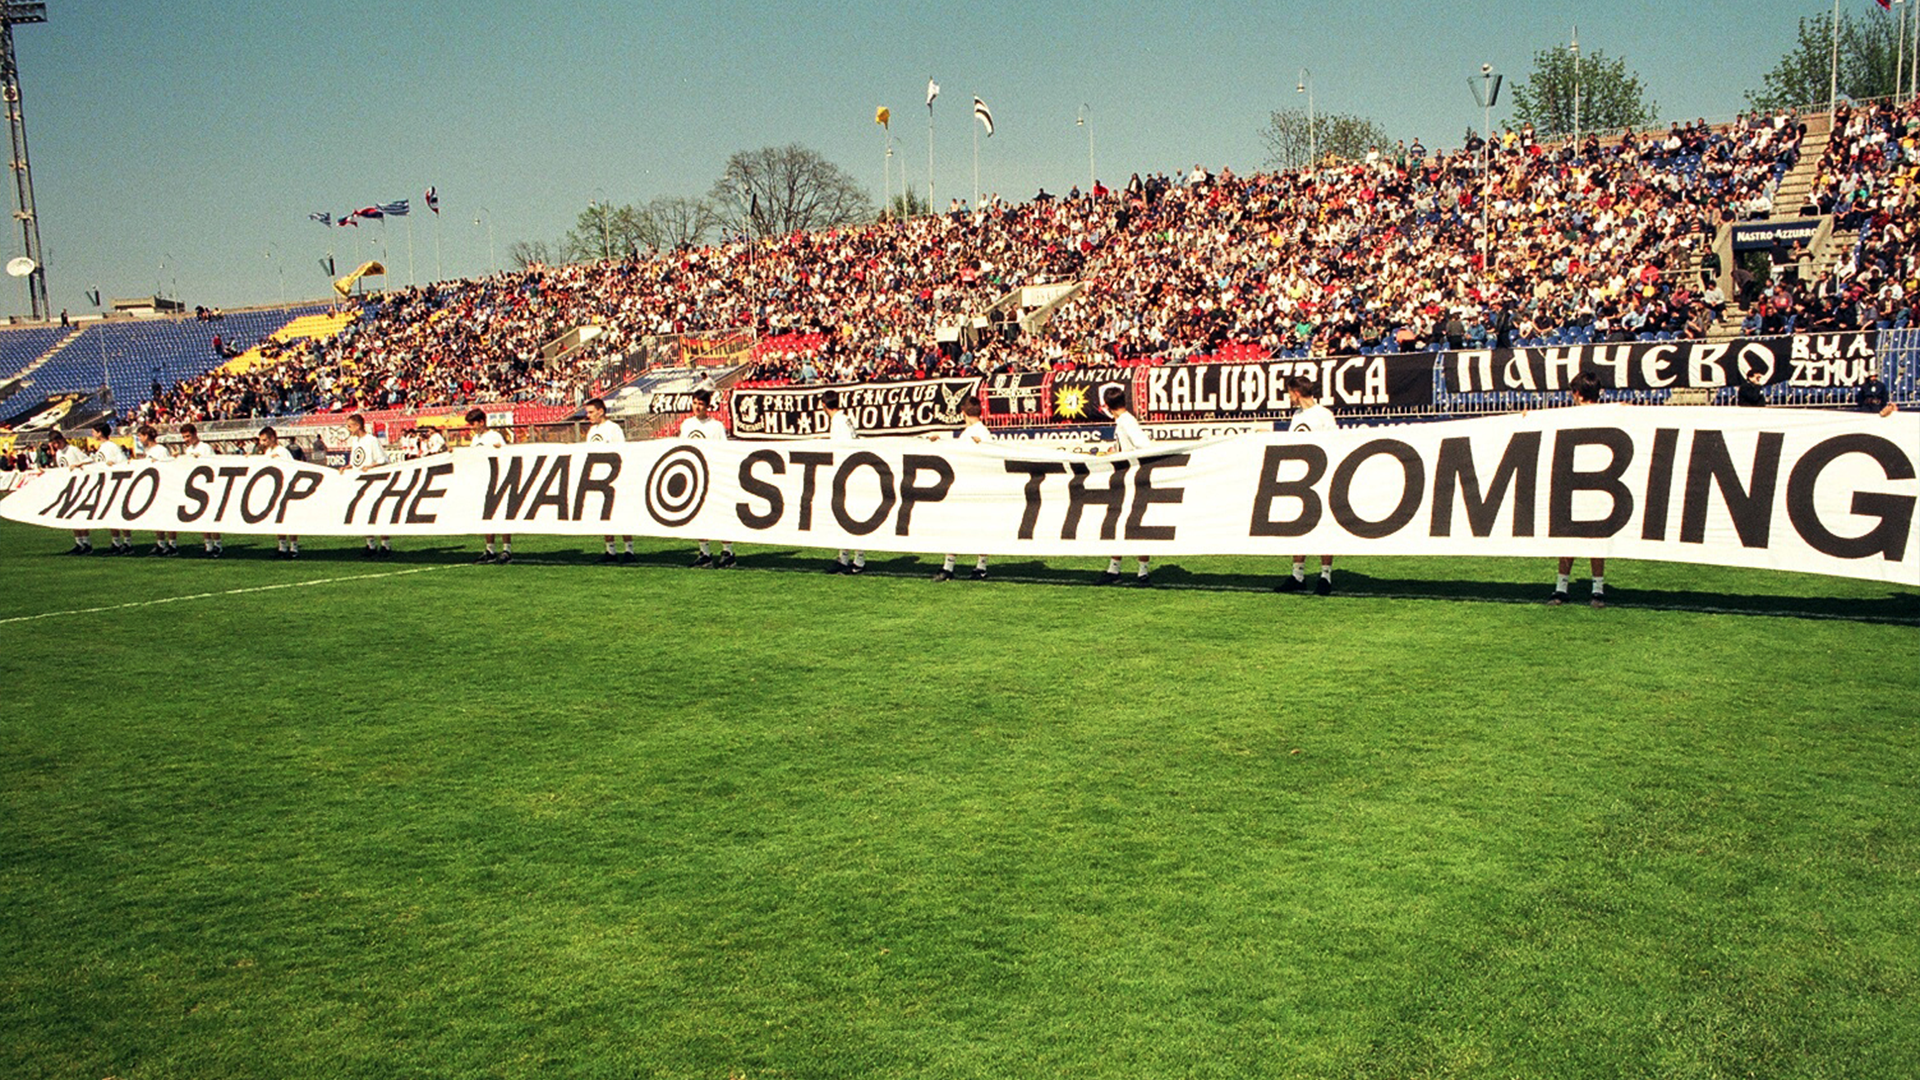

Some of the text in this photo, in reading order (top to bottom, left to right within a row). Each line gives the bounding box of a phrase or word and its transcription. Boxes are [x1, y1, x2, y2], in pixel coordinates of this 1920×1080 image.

[1737, 231, 1773, 242] NASTRO
[1055, 367, 1132, 382] OFANZIVA
[763, 392, 851, 411] PARTIN
[764, 402, 935, 434] MLADNOVAC
[39, 428, 1917, 563] NATO STOP THE WAR STOP THE BOMBING
